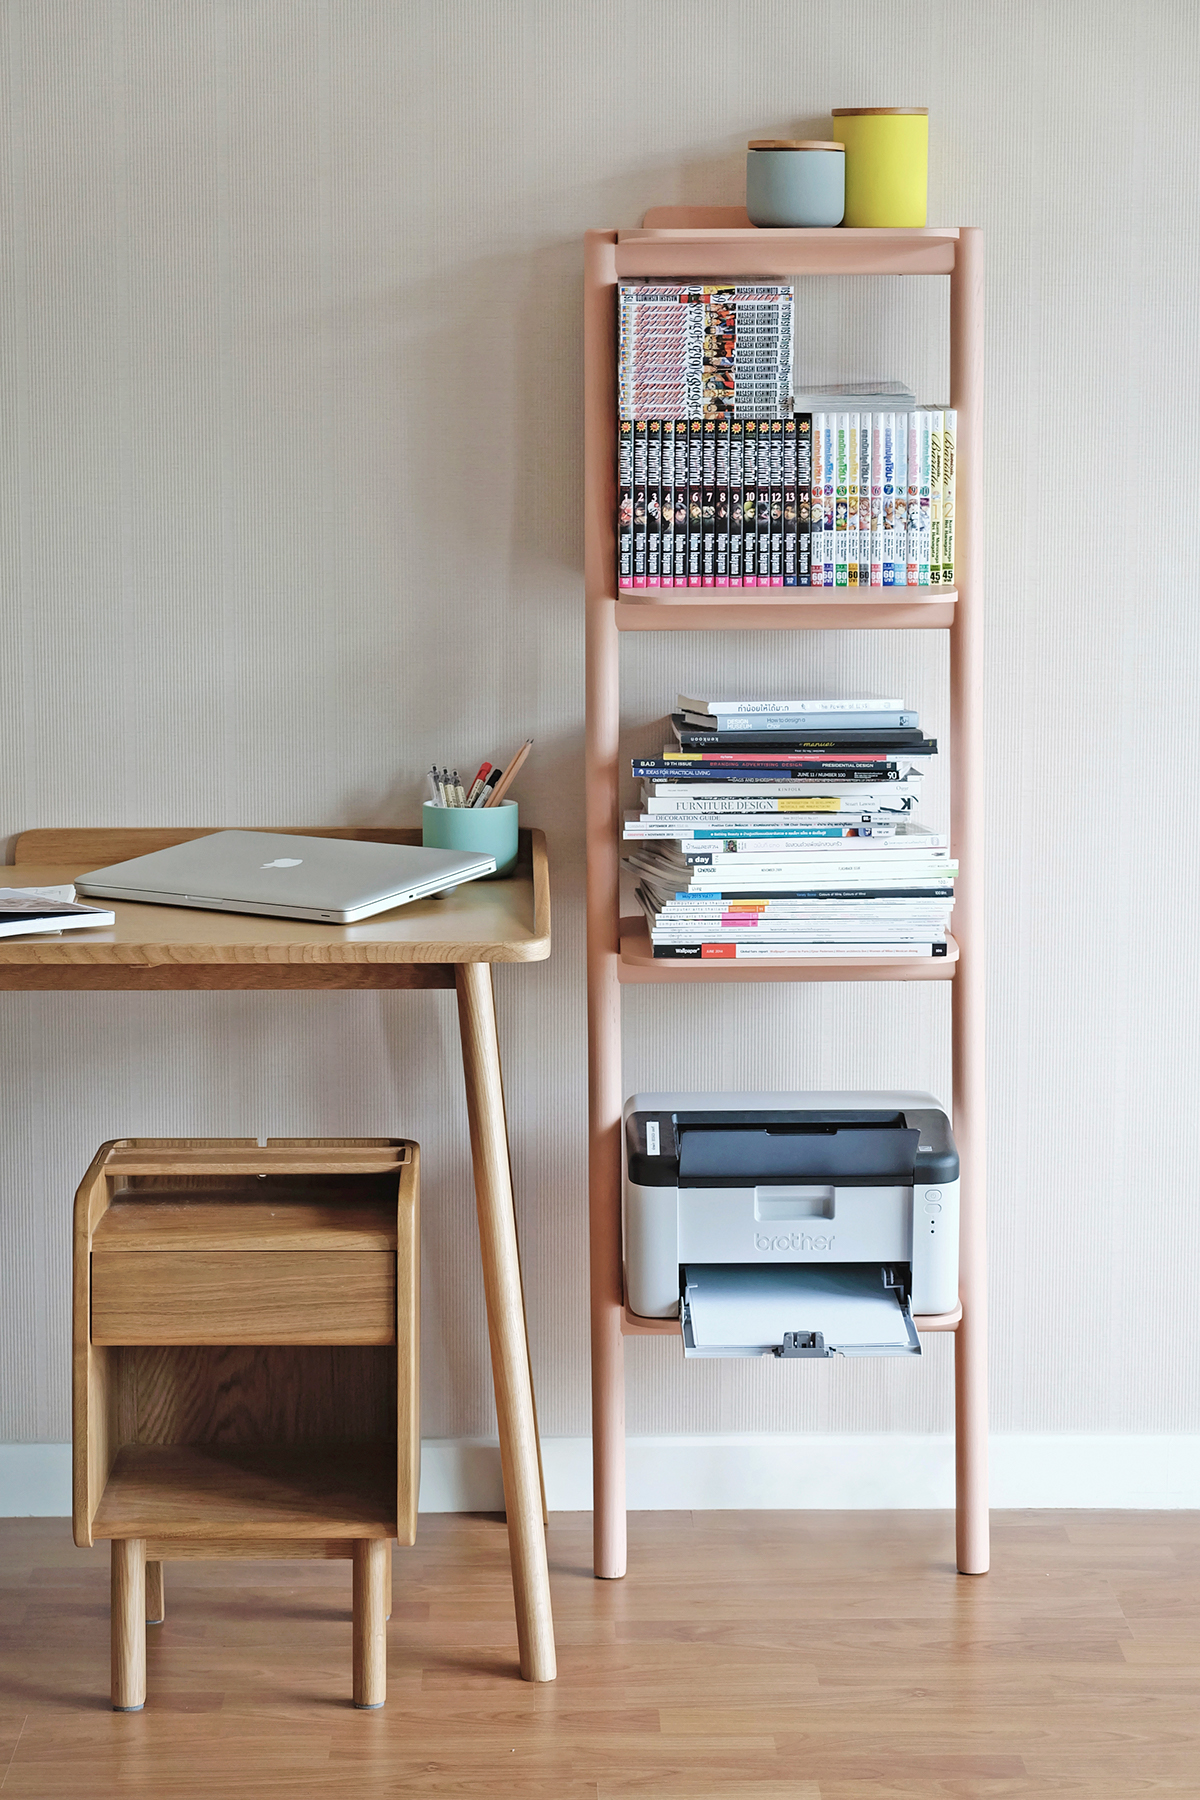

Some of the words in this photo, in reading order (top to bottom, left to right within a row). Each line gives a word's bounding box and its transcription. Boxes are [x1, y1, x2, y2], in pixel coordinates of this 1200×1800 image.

[638, 492, 644, 501] 2
[652, 492, 658, 502] 3
[664, 493, 671, 502] 4
[678, 494, 684, 502] 5
[692, 492, 698, 501] 6
[706, 493, 713, 502] 7
[720, 492, 726, 502] 8
[732, 494, 739, 503] 9
[746, 492, 755, 502] 10
[760, 493, 768, 502] 11
[772, 492, 782, 502] 12
[785, 492, 795, 502] 13
[800, 492, 810, 502] 14
[944, 502, 954, 518] 2
[836, 572, 848, 580] 60
[848, 570, 858, 578] 60
[884, 570, 894, 578] 60
[930, 572, 940, 580] 45
[942, 570, 954, 578] 45
[888, 772, 898, 780] 90
[676, 802, 734, 810] FURNITURE
[736, 801, 774, 810] DESIGN
[754, 1232, 836, 1251] brother
